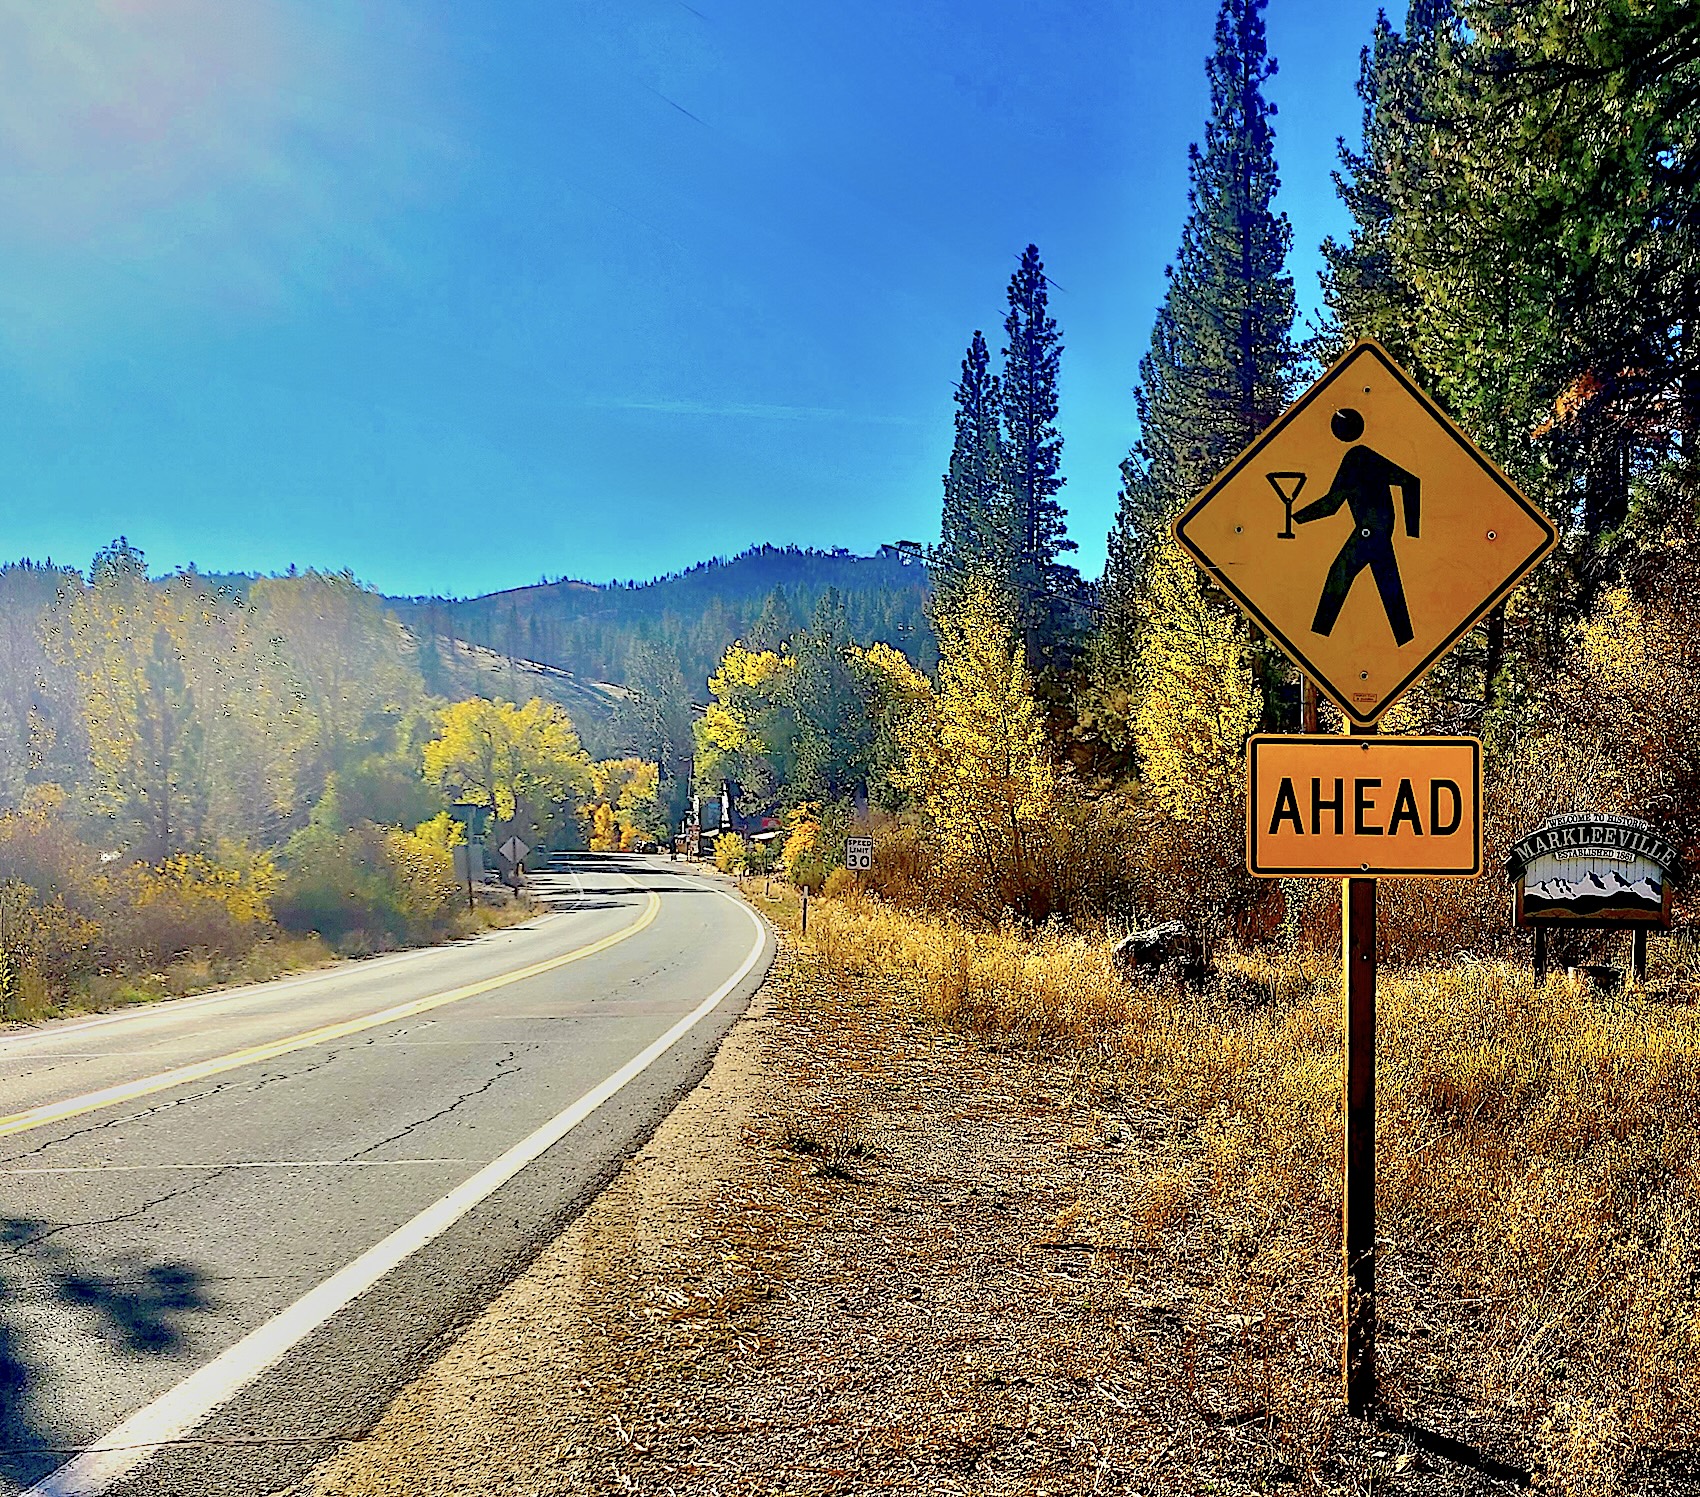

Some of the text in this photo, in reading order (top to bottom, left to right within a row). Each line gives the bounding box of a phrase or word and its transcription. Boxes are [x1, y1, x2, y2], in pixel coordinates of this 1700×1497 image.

[1268, 777, 1462, 836] AHEAD
[1547, 813, 1647, 831] WELCOME TO HISTORIC
[1514, 826, 1678, 866] MARKLEEVILLE
[1558, 849, 1614, 859] ESTABLISHED
[848, 855, 869, 867] 30
